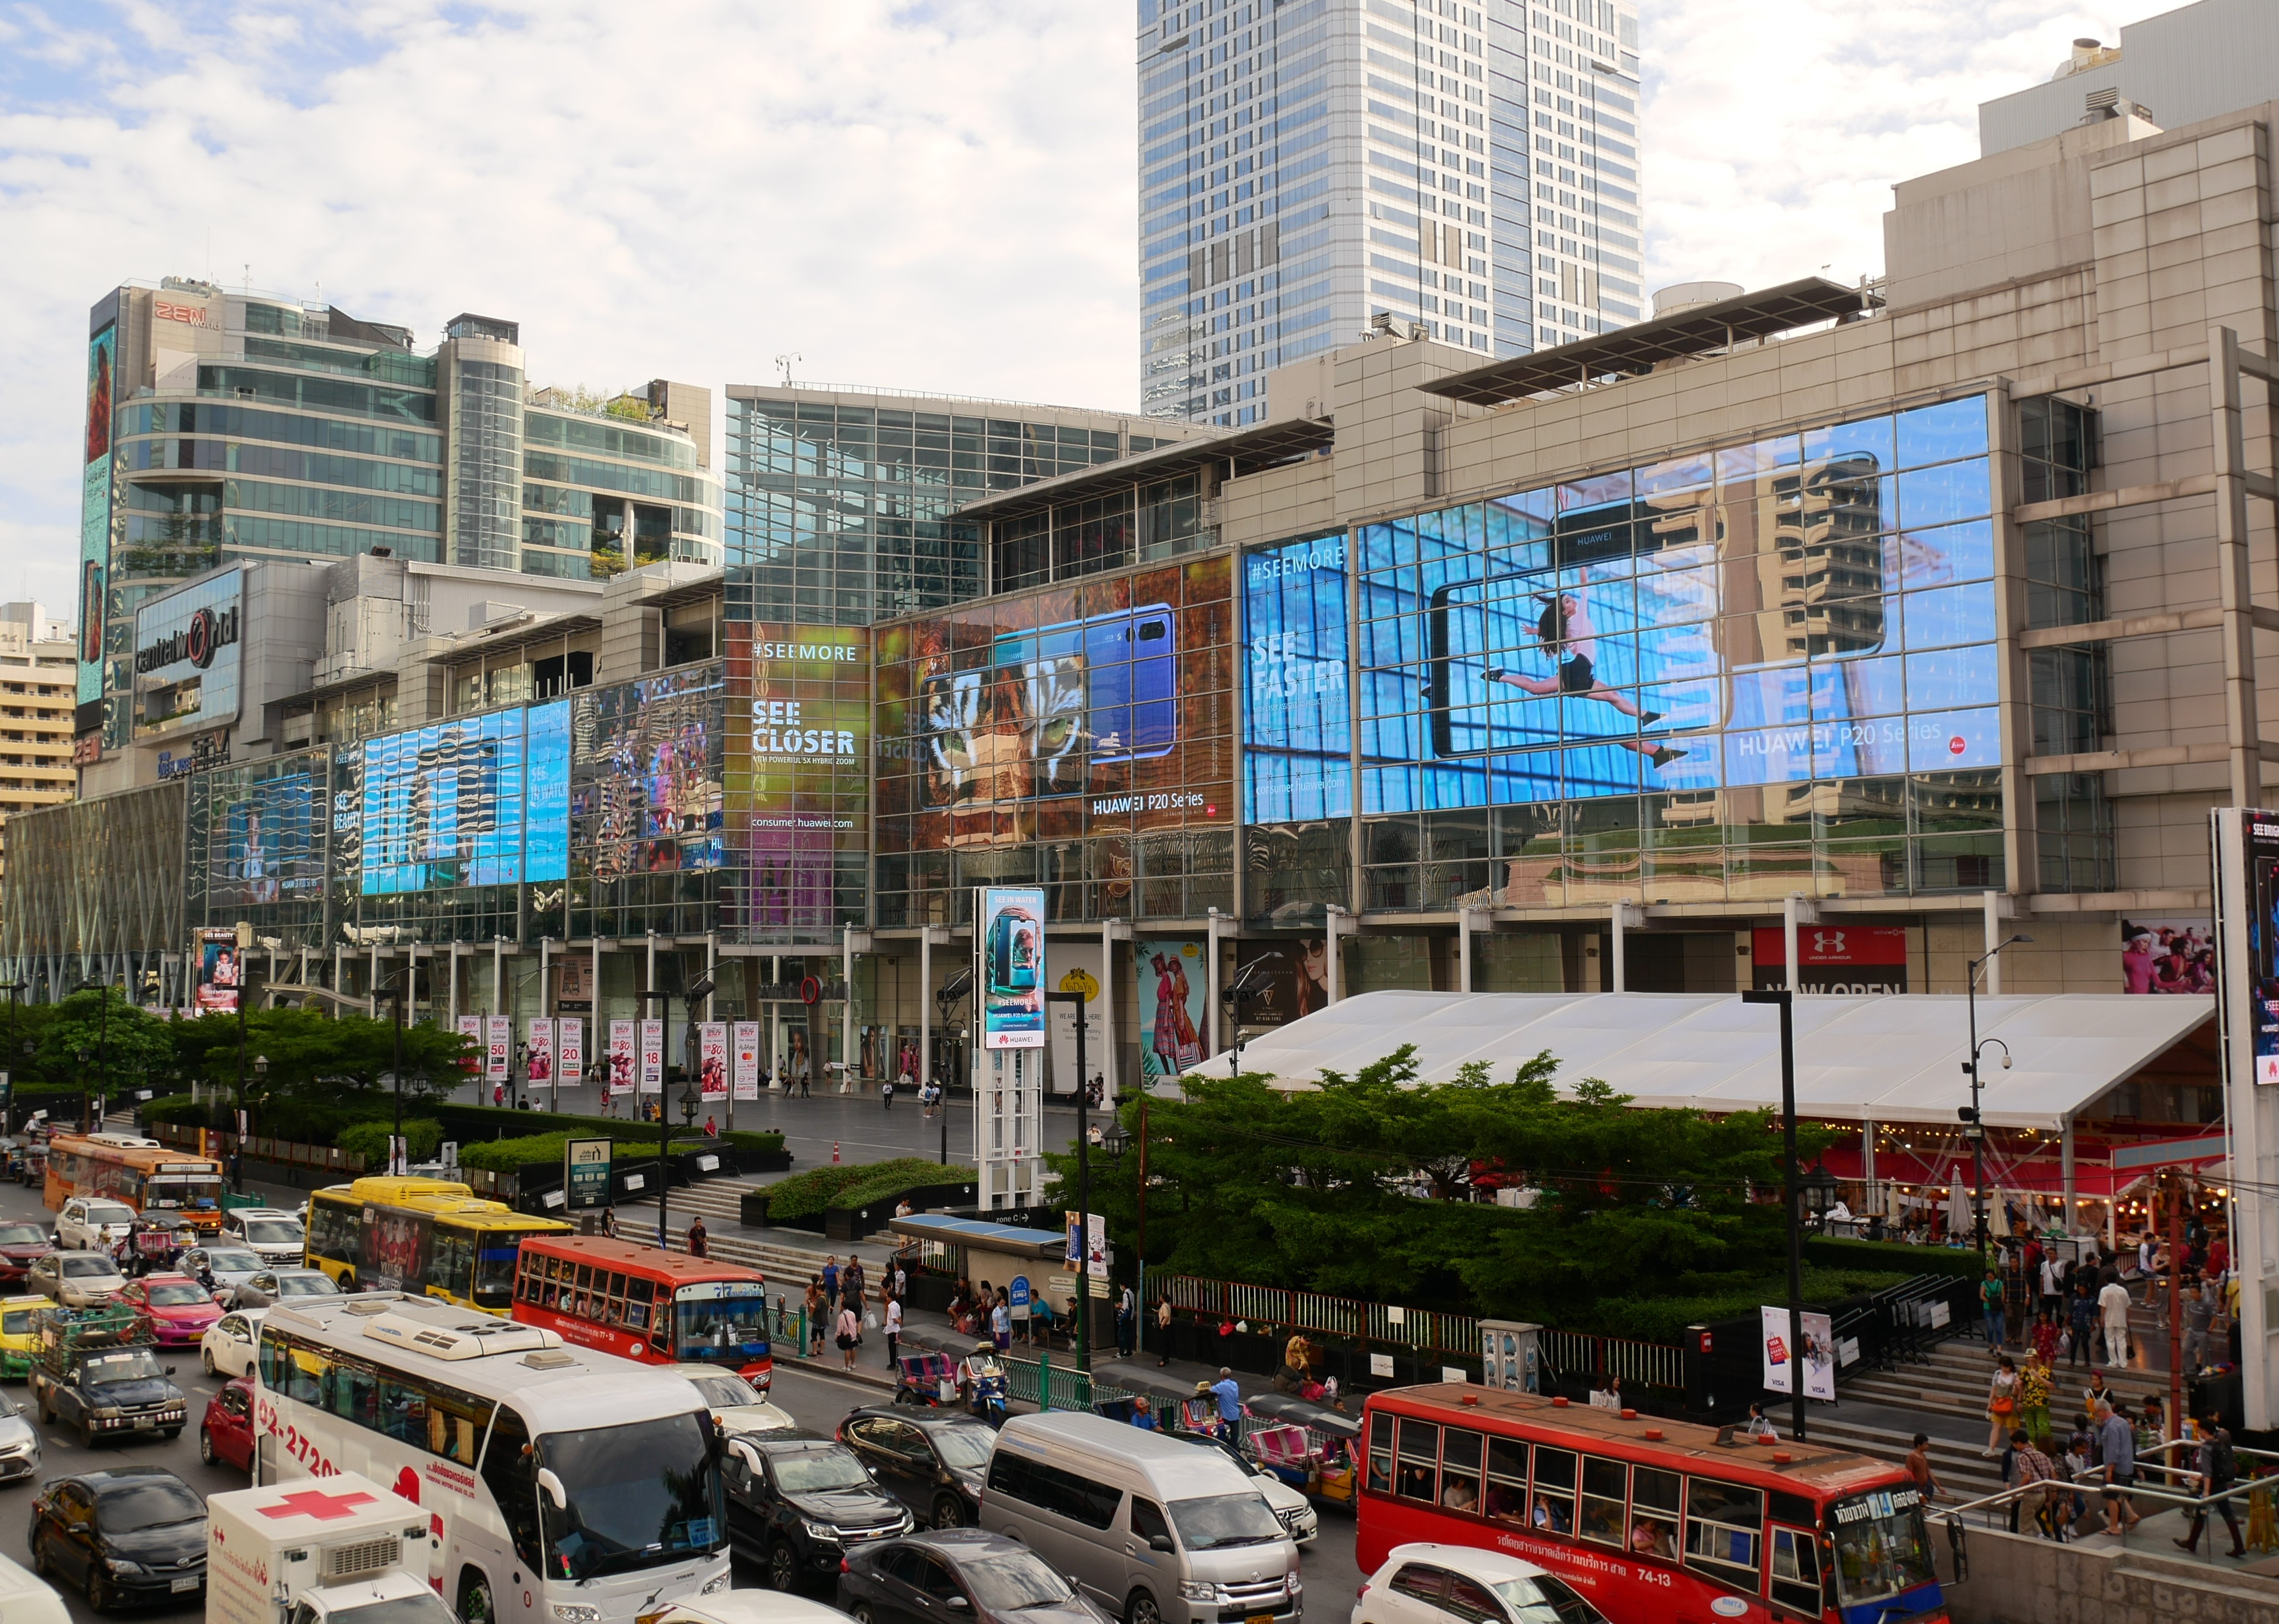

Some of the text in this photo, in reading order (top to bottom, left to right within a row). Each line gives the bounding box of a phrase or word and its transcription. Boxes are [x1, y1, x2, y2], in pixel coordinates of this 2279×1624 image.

[155, 301, 206, 323] ZEN
[190, 317, 220, 331] World
[1578, 532, 1611, 546] HUAWEI
[1252, 546, 1343, 581] #SEEMORE
[753, 643, 856, 662] #SEEMORE
[1254, 631, 1296, 666] SEE
[1254, 660, 1344, 701] FASTER
[1331, 695, 1345, 703] FOCUS
[753, 701, 801, 725] SEE
[753, 728, 855, 754] CLOSER
[1739, 720, 1941, 756] HUAWEI P20 Series
[532, 766, 546, 782] SEE
[541, 781, 568, 800] WATER
[1256, 778, 1344, 795] consumer.huawei.com
[334, 793, 347, 812] SEE
[1093, 791, 1204, 815] HUAWEI P20 Series
[333, 811, 361, 830] BEAUTY
[752, 818, 853, 828] consumer.huawei.com
[2253, 823, 2264, 835] SEE
[2265, 1000, 2279, 1011] #SEE
[381, 1261, 403, 1278] YUASA
[379, 1276, 402, 1291] BATTERY
[714, 1285, 732, 1298] 77
[259, 1398, 342, 1478] 02-2720
[441, 1481, 454, 1490] MOTORS
[454, 1486, 463, 1494] SALES
[1610, 1563, 1626, 1576] สาย
[1637, 1568, 1671, 1587] 74-13
[1722, 1597, 1743, 1610] BMTA
